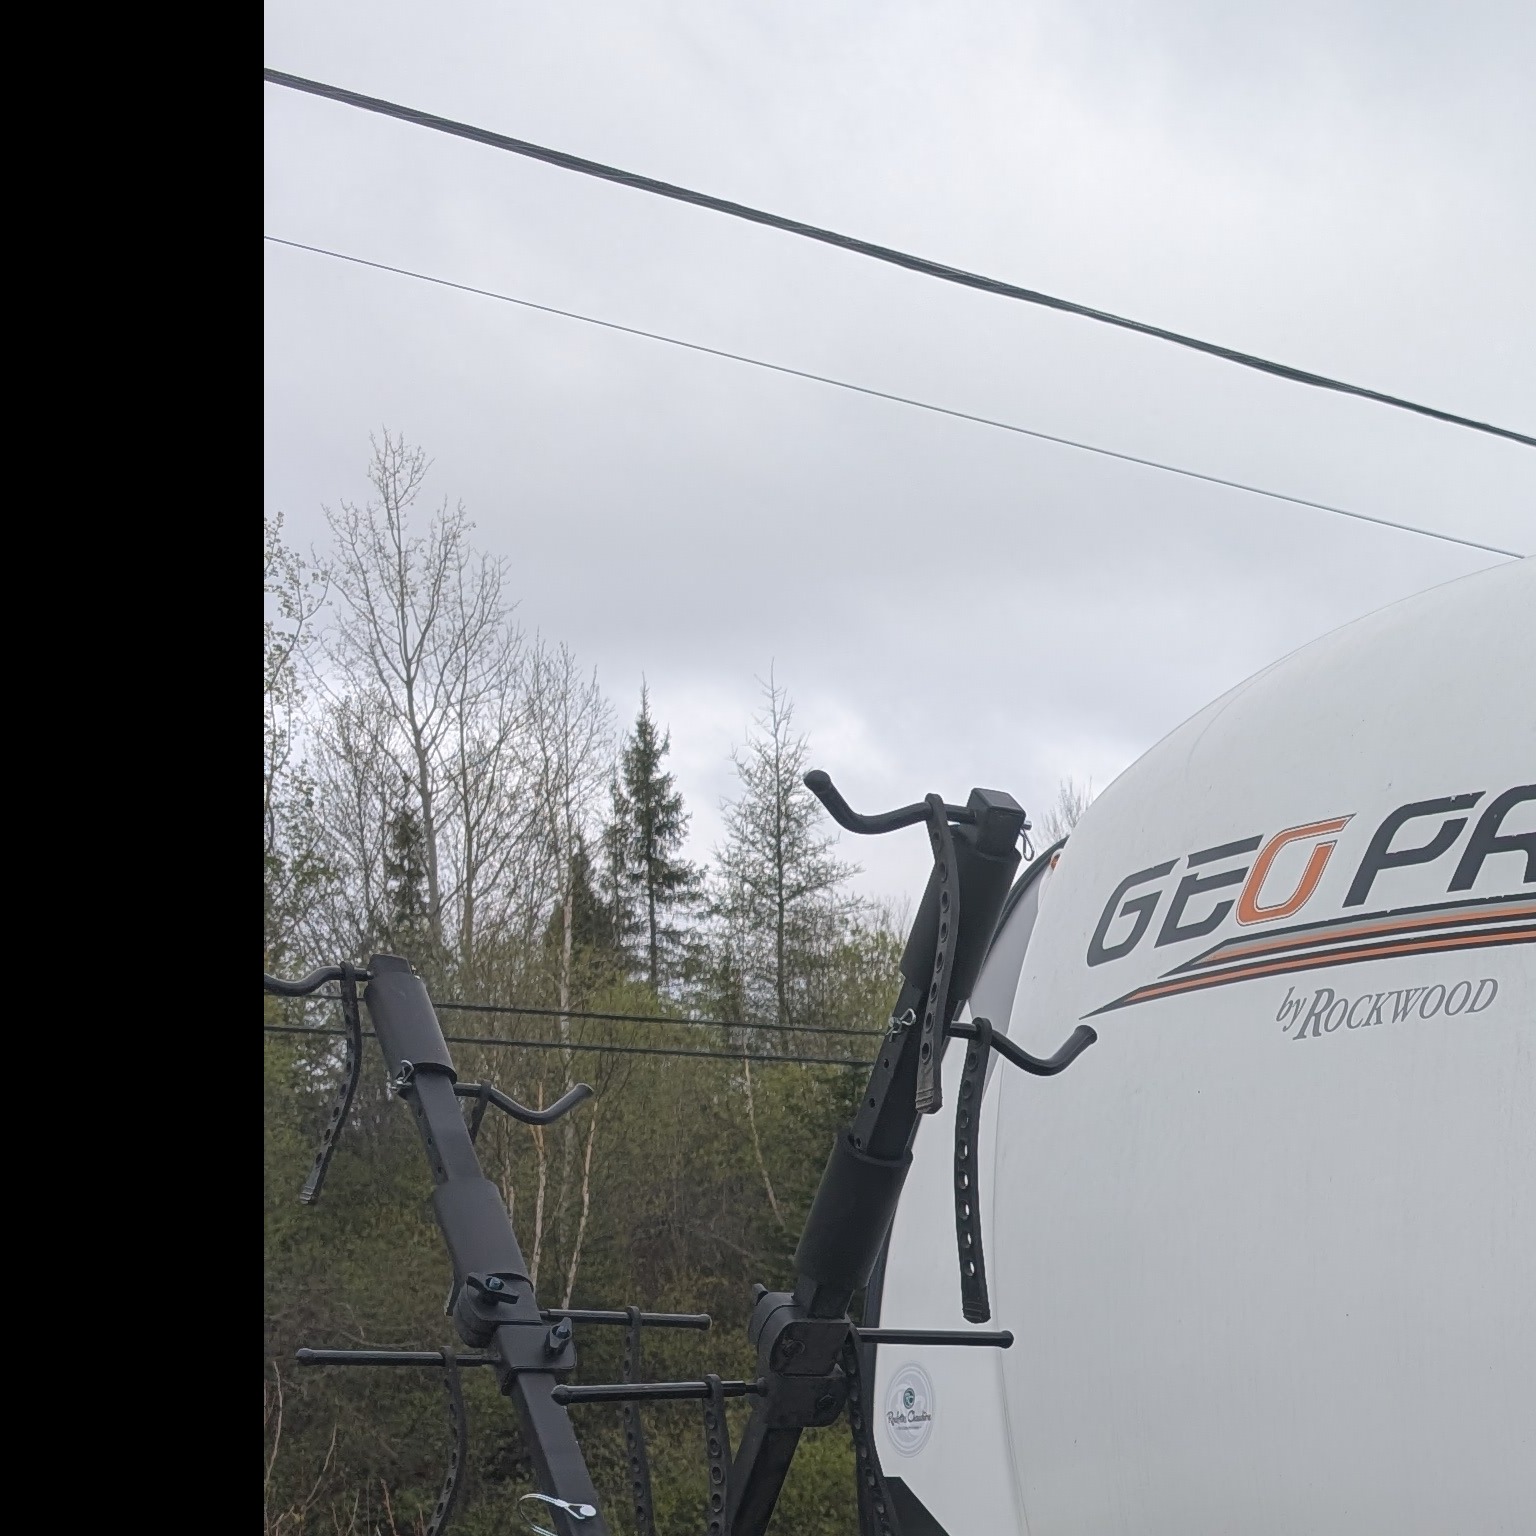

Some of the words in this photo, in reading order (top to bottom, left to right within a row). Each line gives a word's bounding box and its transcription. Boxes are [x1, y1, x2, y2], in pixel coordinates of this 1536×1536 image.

[1086, 813, 1357, 967] GEO
[1276, 986, 1308, 1032] by
[1292, 978, 1499, 1041] ROCKWOOD
